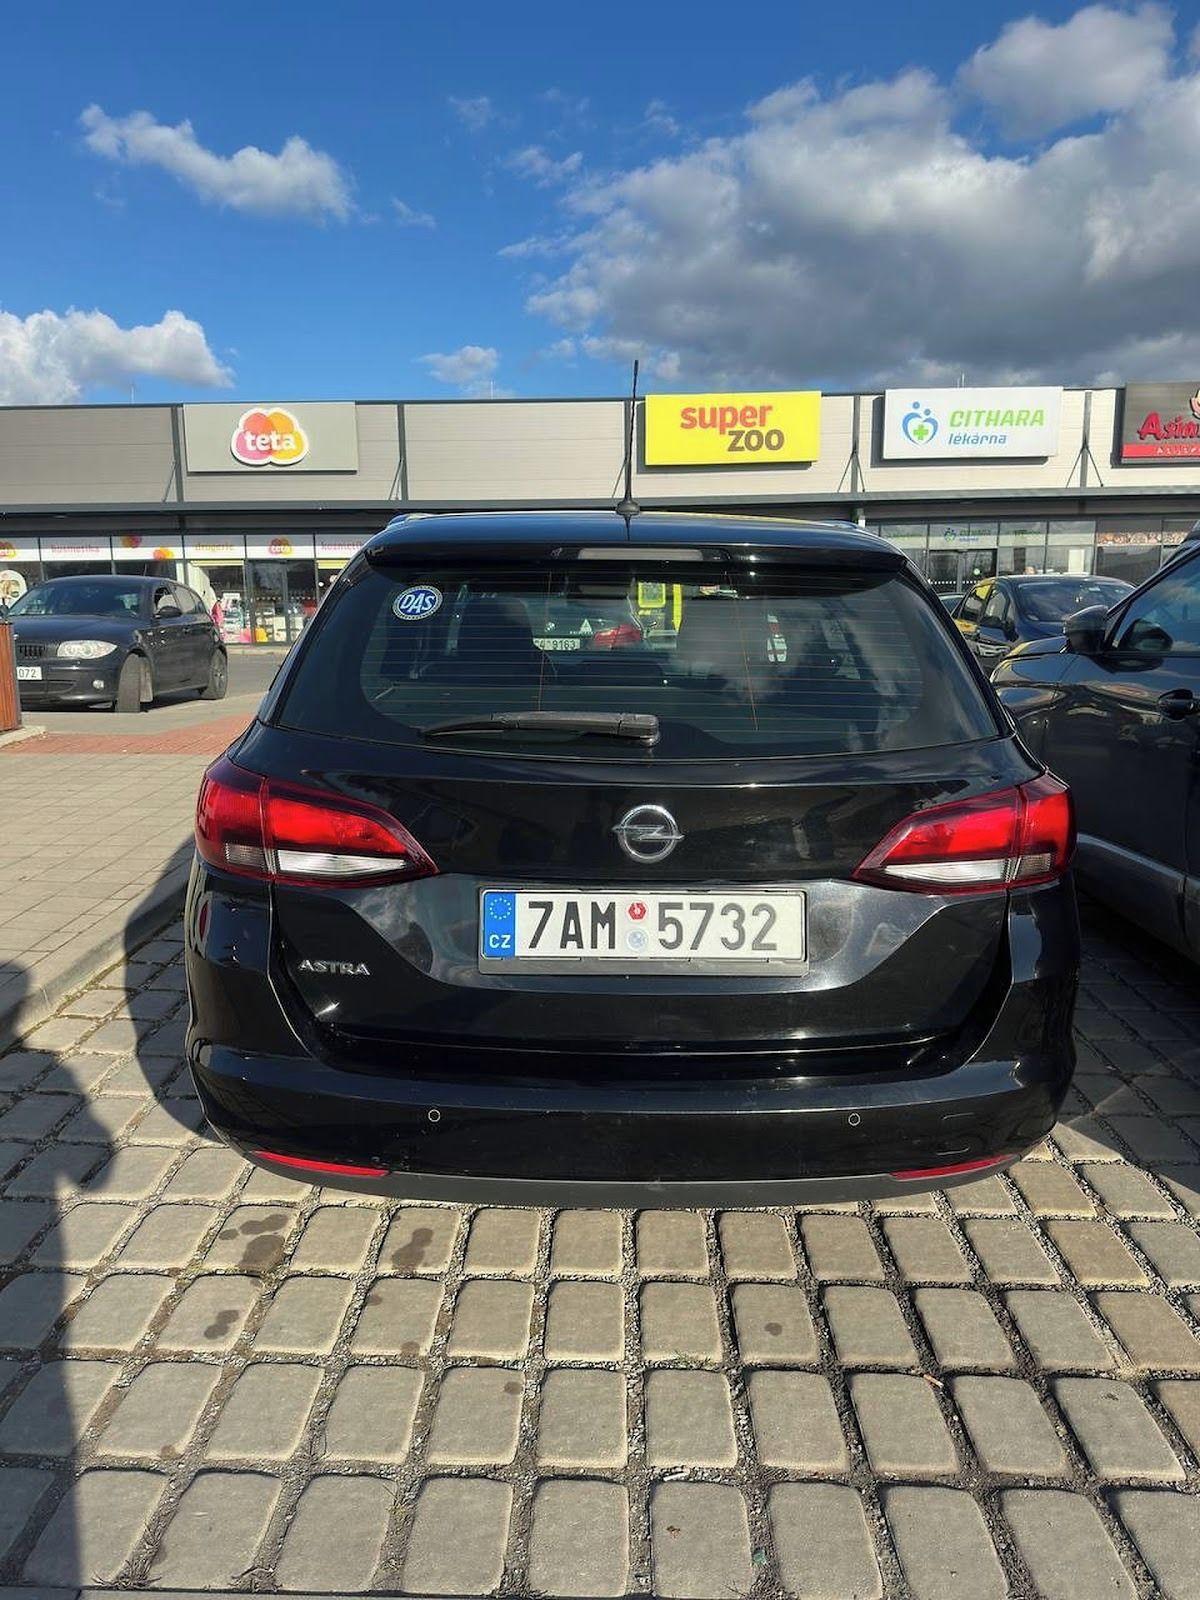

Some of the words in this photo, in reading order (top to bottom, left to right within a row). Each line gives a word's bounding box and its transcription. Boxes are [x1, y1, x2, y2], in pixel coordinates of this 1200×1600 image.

[681, 405, 773, 435] super
[950, 410, 1045, 427] CITHARA
[244, 431, 295, 451] teta
[948, 433, 1007, 445] lékárna
[528, 901, 616, 950] 7AM
[658, 902, 777, 951] 5732
[489, 934, 511, 949] CZ
[298, 960, 371, 976] ASTRA
